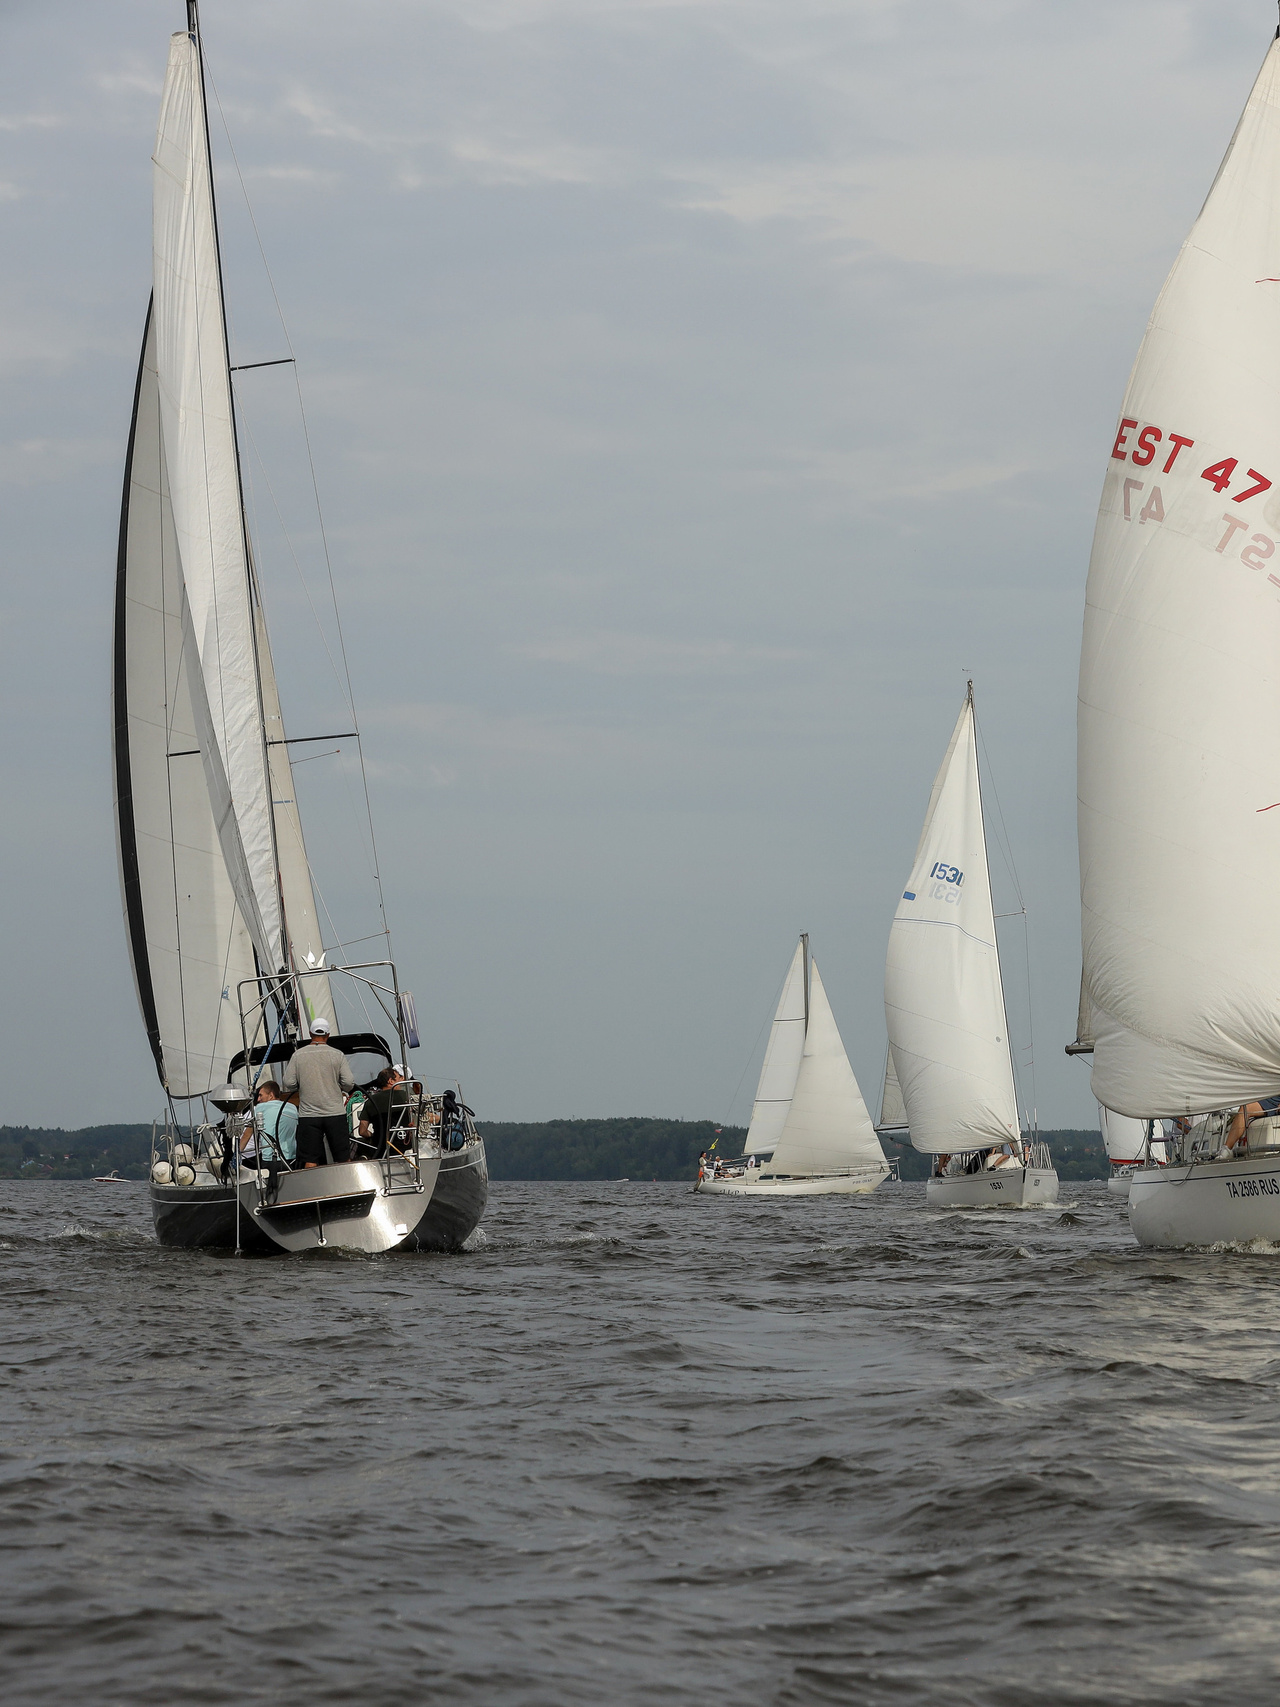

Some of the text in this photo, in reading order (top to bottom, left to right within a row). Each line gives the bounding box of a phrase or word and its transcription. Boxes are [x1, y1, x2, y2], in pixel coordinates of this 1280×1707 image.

[1111, 418, 1273, 504] EST 47
[990, 1181, 1004, 1190] 1531
[1225, 1182, 1240, 1198] TA
[1238, 1179, 1260, 1198] 2586
[1258, 1178, 1280, 1196] RUS
